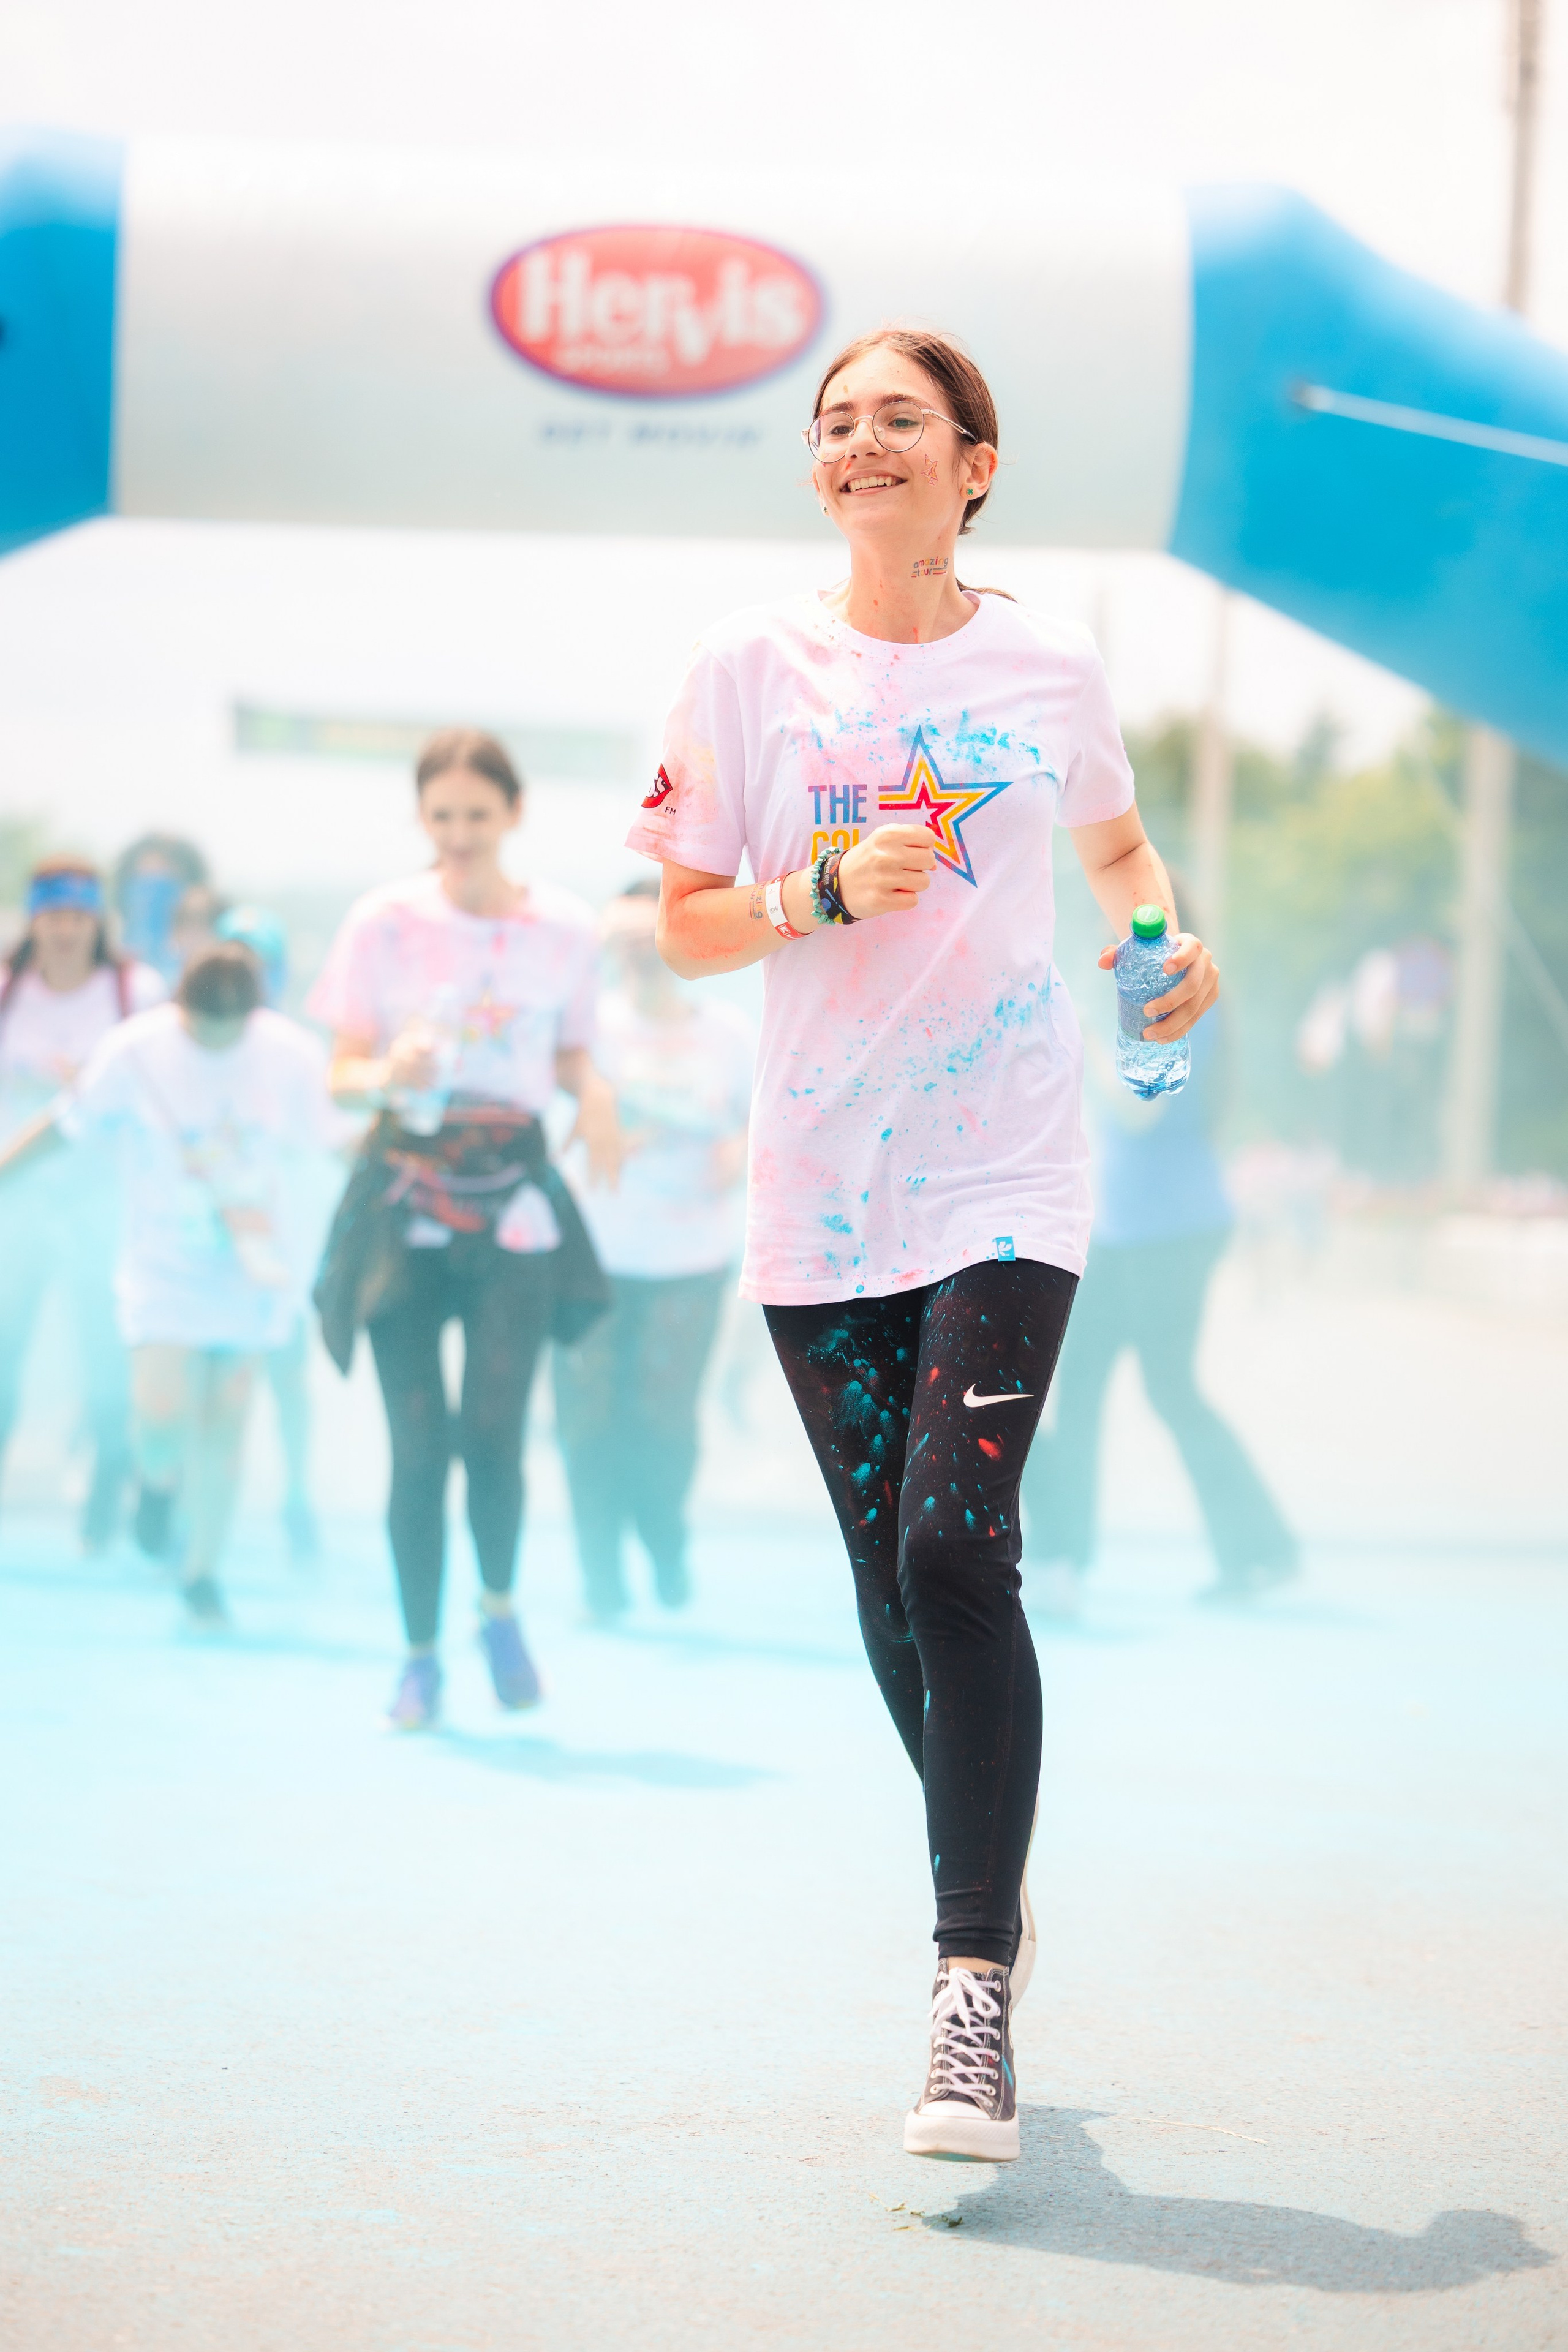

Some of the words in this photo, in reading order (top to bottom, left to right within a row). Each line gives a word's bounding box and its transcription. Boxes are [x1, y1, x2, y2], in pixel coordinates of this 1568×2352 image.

[519, 250, 804, 364] Hervis
[913, 556, 949, 568] amazing
[917, 568, 932, 577] tour
[665, 806, 676, 815] FM
[808, 784, 867, 825] THE
